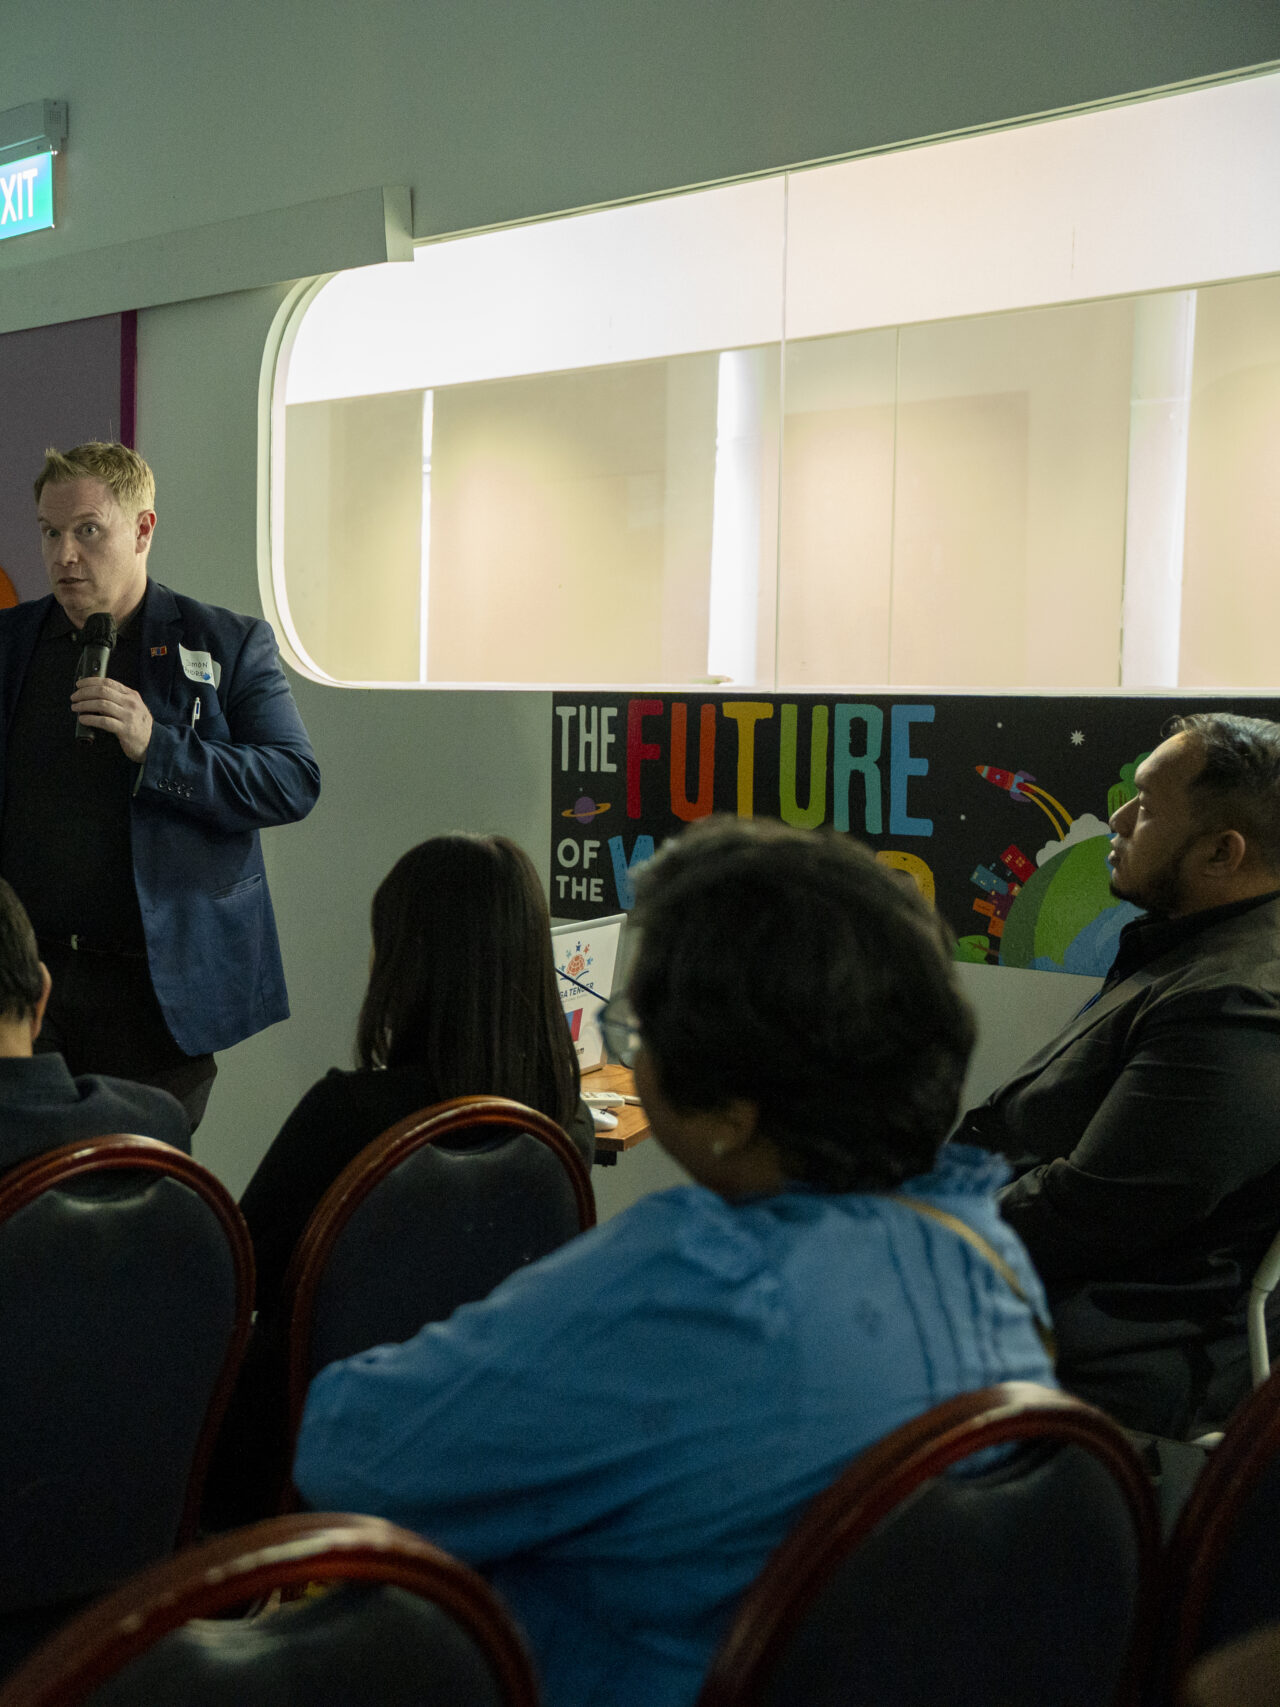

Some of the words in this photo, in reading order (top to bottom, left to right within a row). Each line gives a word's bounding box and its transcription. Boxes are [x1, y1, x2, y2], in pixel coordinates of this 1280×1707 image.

[556, 705, 618, 773] THE
[626, 699, 936, 838] FUTURE
[557, 838, 601, 869] OF
[556, 875, 604, 902] THE
